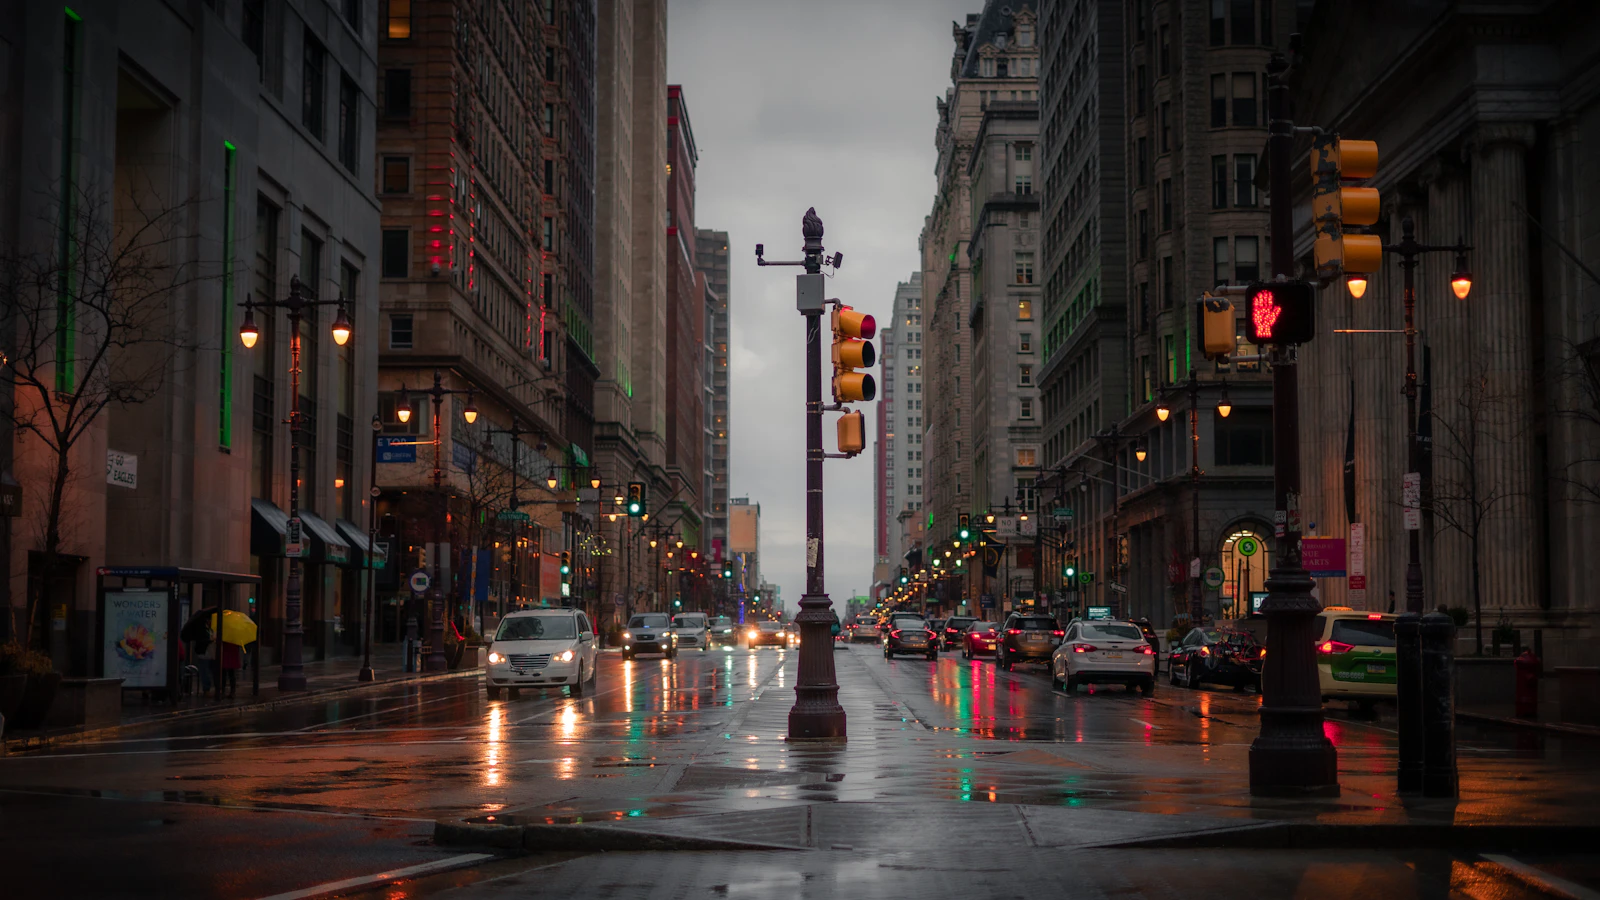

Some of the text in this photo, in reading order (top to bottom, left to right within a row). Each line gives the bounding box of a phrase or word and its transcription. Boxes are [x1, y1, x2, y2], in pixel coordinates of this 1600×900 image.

[116, 455, 124, 466] GO
[1309, 558, 1330, 566] ARTS
[113, 600, 161, 609] WONDERS
[127, 610, 157, 618] WATER
